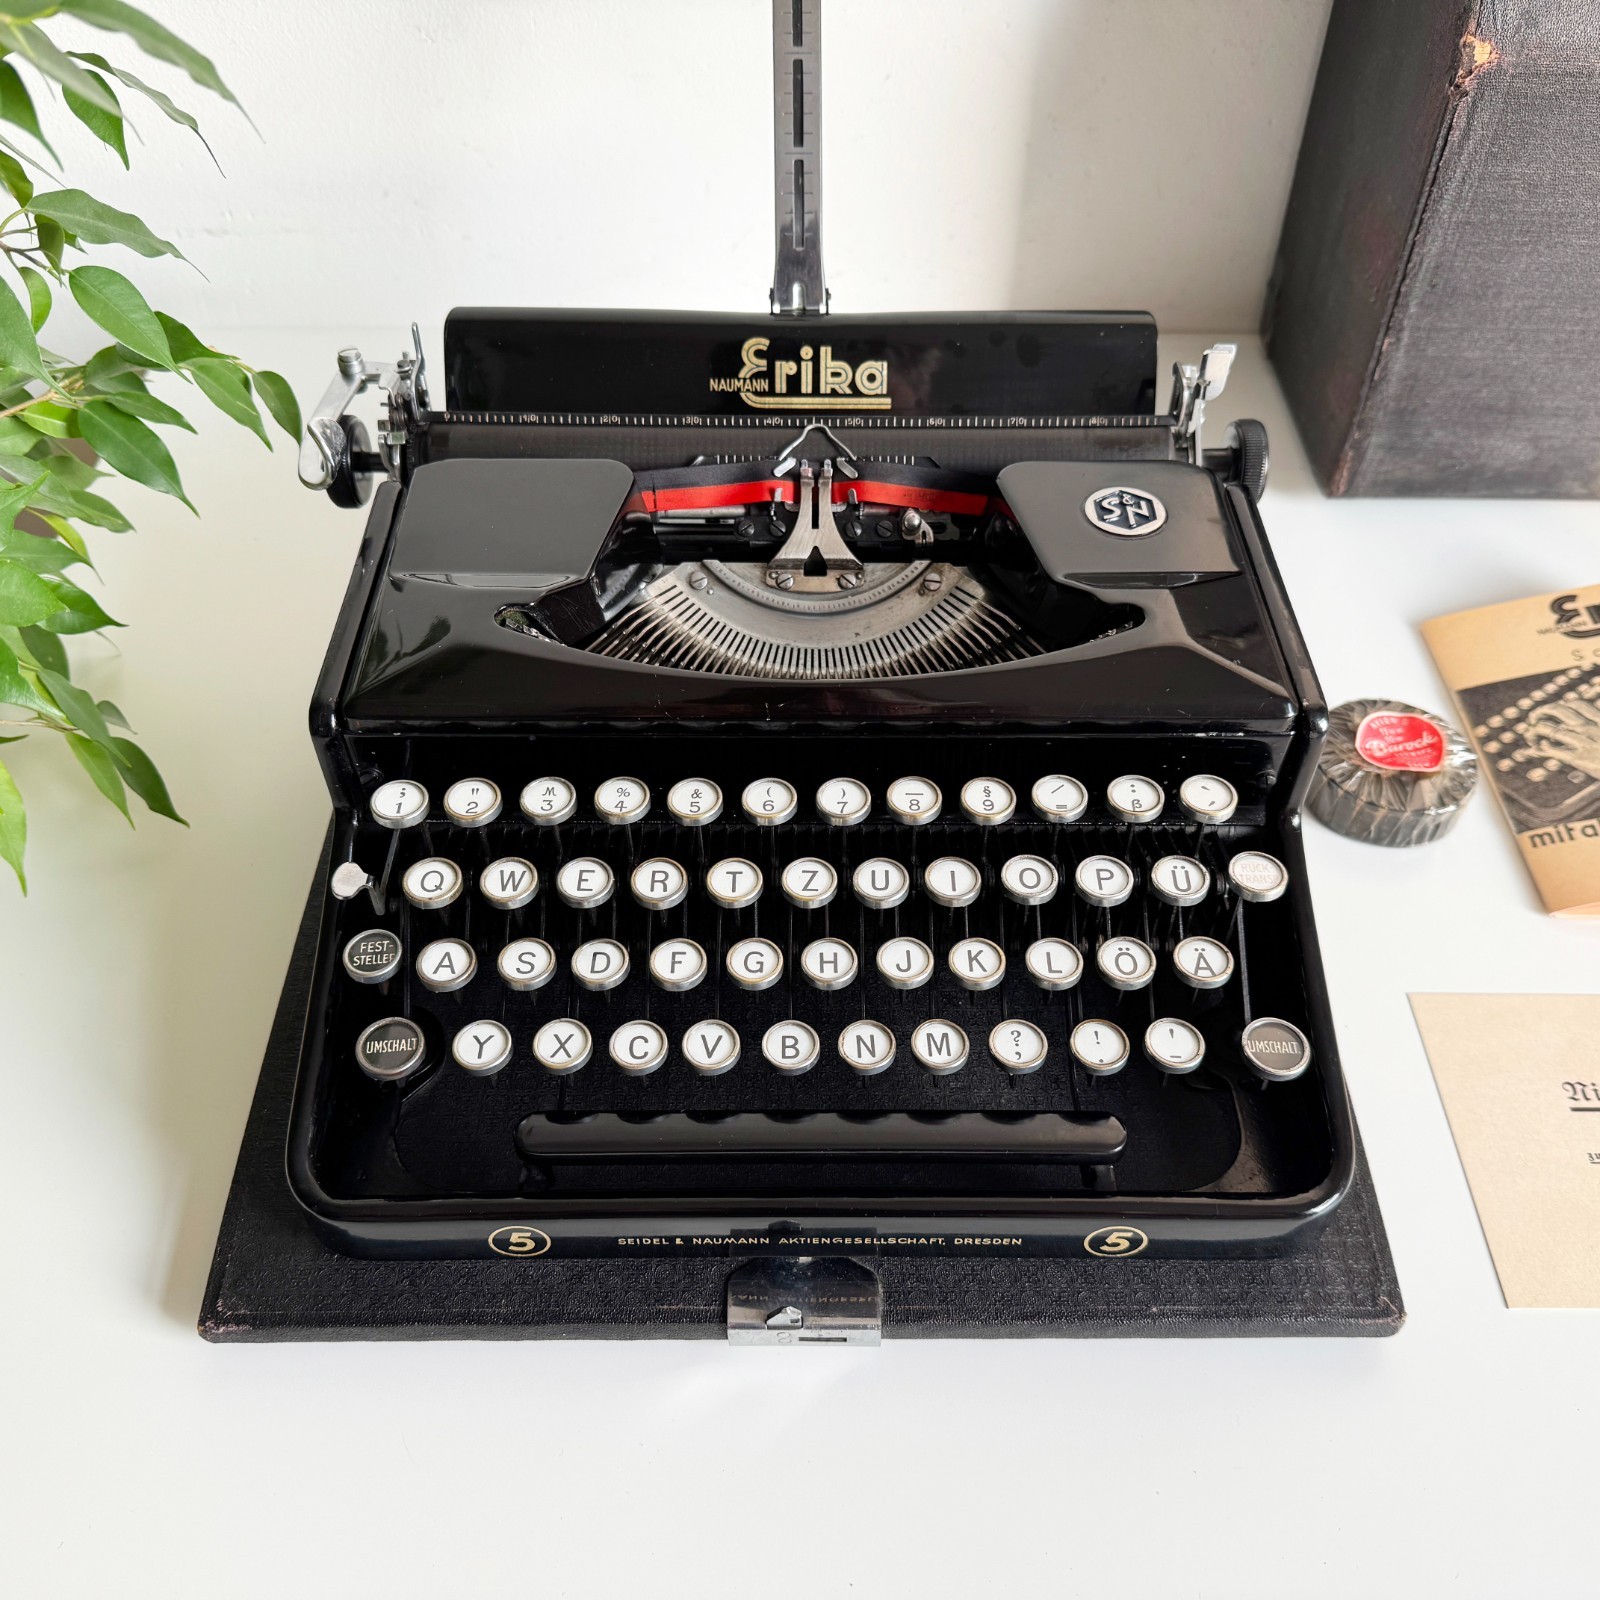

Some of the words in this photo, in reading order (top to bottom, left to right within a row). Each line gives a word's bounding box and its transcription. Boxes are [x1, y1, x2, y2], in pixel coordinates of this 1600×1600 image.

[738, 337, 891, 409] Erika
[709, 378, 769, 392] NAUMANN
[602, 415, 619, 424] 20
[685, 416, 701, 425] 30
[766, 417, 781, 426] 40
[929, 418, 943, 426] 60
[1010, 417, 1025, 426] 70
[617, 787, 631, 798] %
[690, 788, 703, 799] &
[396, 802, 403, 814] 1
[465, 801, 479, 814] 2
[540, 799, 553, 812] 3
[614, 800, 628, 813] 4
[689, 801, 701, 814] 5
[762, 799, 775, 812] 6
[837, 801, 849, 814] 7
[908, 798, 921, 812] 8
[982, 799, 995, 812] 9
[1529, 823, 1574, 848] mit
[419, 870, 445, 892] Q
[499, 869, 527, 891] W
[576, 869, 596, 891] E
[650, 870, 669, 892] R
[725, 871, 744, 892] T
[801, 870, 819, 891] Z
[871, 869, 890, 890] U
[950, 870, 957, 891] I
[1018, 867, 1041, 889] O
[1095, 868, 1115, 890] P
[1171, 865, 1192, 892] Ü
[360, 940, 394, 954] FEST-
[432, 951, 456, 974] A
[515, 951, 536, 974] S
[589, 951, 611, 973] D
[670, 951, 687, 973] F
[743, 951, 765, 973] G
[819, 952, 839, 973] H
[895, 949, 912, 972] J
[967, 949, 988, 972] K
[1046, 951, 1063, 973] L
[1114, 947, 1138, 975] Ö
[1192, 947, 1217, 977] Ä
[366, 1037, 418, 1054] UMSCHALT
[472, 1034, 495, 1059] Y
[549, 1033, 575, 1058] X
[628, 1035, 649, 1059] C
[700, 1034, 723, 1058] V
[781, 1035, 800, 1059] B
[855, 1034, 876, 1058] N
[926, 1032, 952, 1056] M
[1010, 1030, 1022, 1047] ?
[1094, 1030, 1101, 1045] !
[508, 1232, 537, 1251] 5
[617, 1237, 670, 1246] SEIDEL
[675, 1237, 685, 1246] &
[692, 1236, 770, 1246] NAUMANN
[953, 1237, 1023, 1246] DRESDEN
[1099, 1231, 1134, 1251] 5
